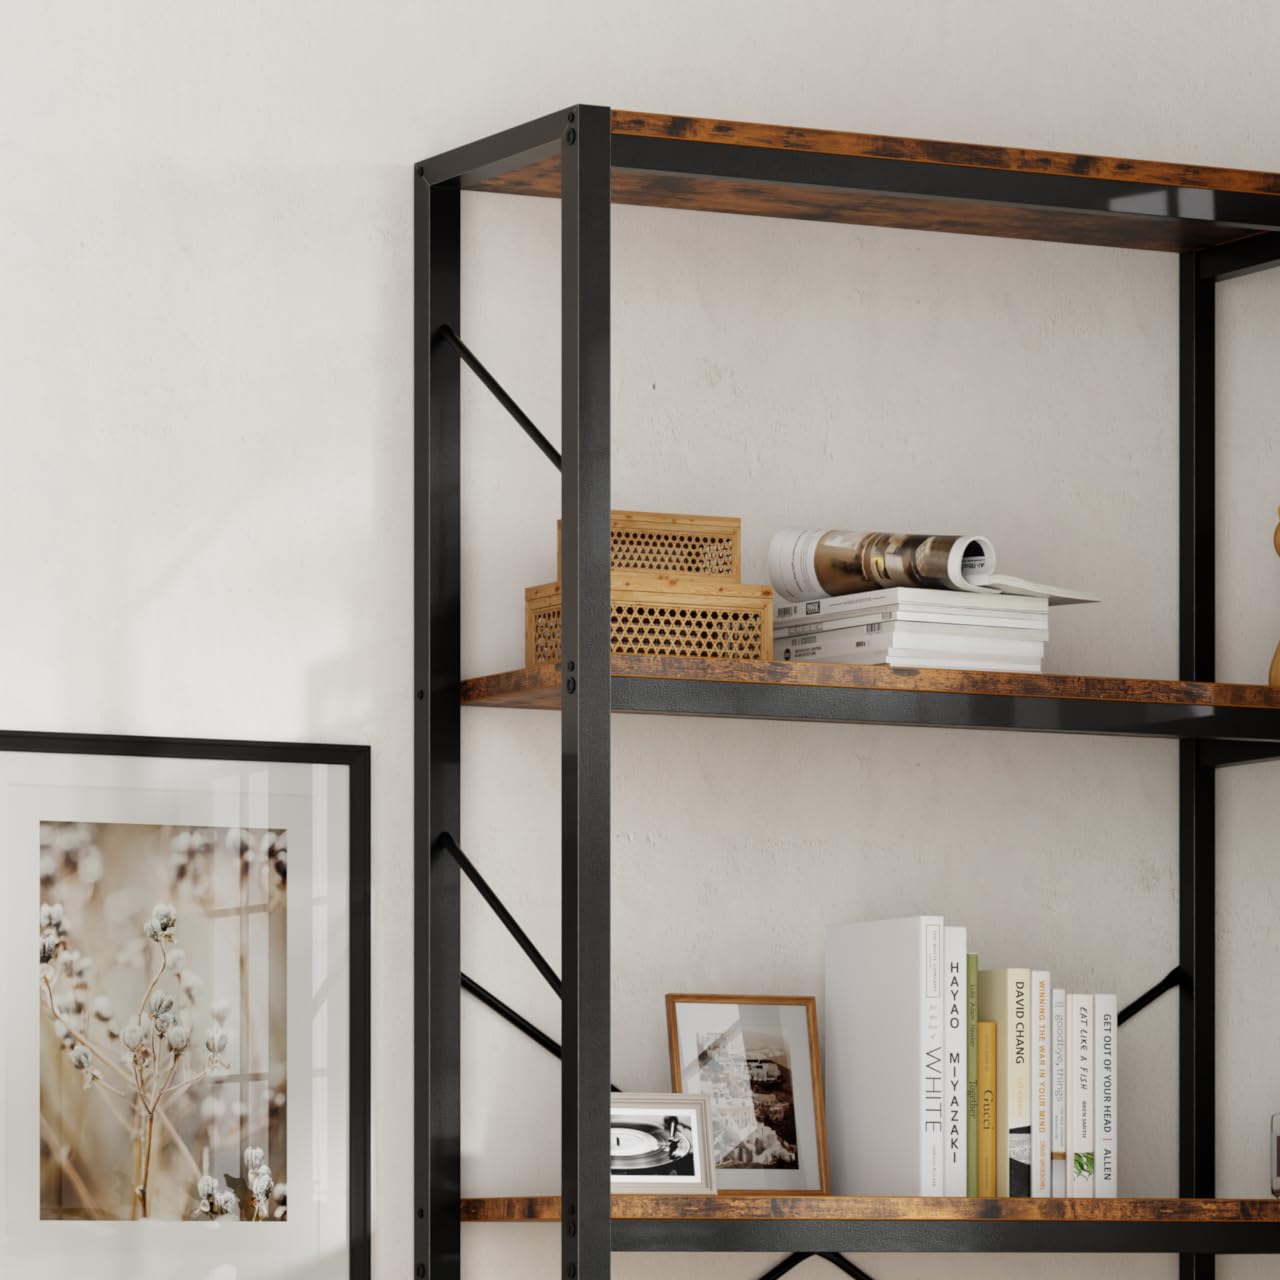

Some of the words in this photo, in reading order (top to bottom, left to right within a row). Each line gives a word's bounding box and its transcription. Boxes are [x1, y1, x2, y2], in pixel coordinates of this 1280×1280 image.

[949, 961, 960, 1029] HAYAO
[1015, 981, 1025, 1019] DAVID
[1080, 1006, 1088, 1027] EAT
[1103, 1013, 1112, 1033] GET
[1015, 1022, 1025, 1064] CHANG
[1080, 1029, 1088, 1052] LIKE
[1103, 1035, 1112, 1056] OUT
[1039, 1068, 1046, 1078] IN
[1080, 1066, 1088, 1091] FISH
[1103, 1058, 1112, 1073] OF
[925, 1046, 942, 1133] WHITE
[967, 1079, 978, 1119] Together
[1055, 1068, 1065, 1103] things
[1103, 1075, 1112, 1102] YOUR
[949, 1052, 960, 1164] MIYAZAKI
[983, 1089, 994, 1131] Gucci
[1103, 1105, 1112, 1133] HEAD
[1103, 1148, 1112, 1181] ALLEN
